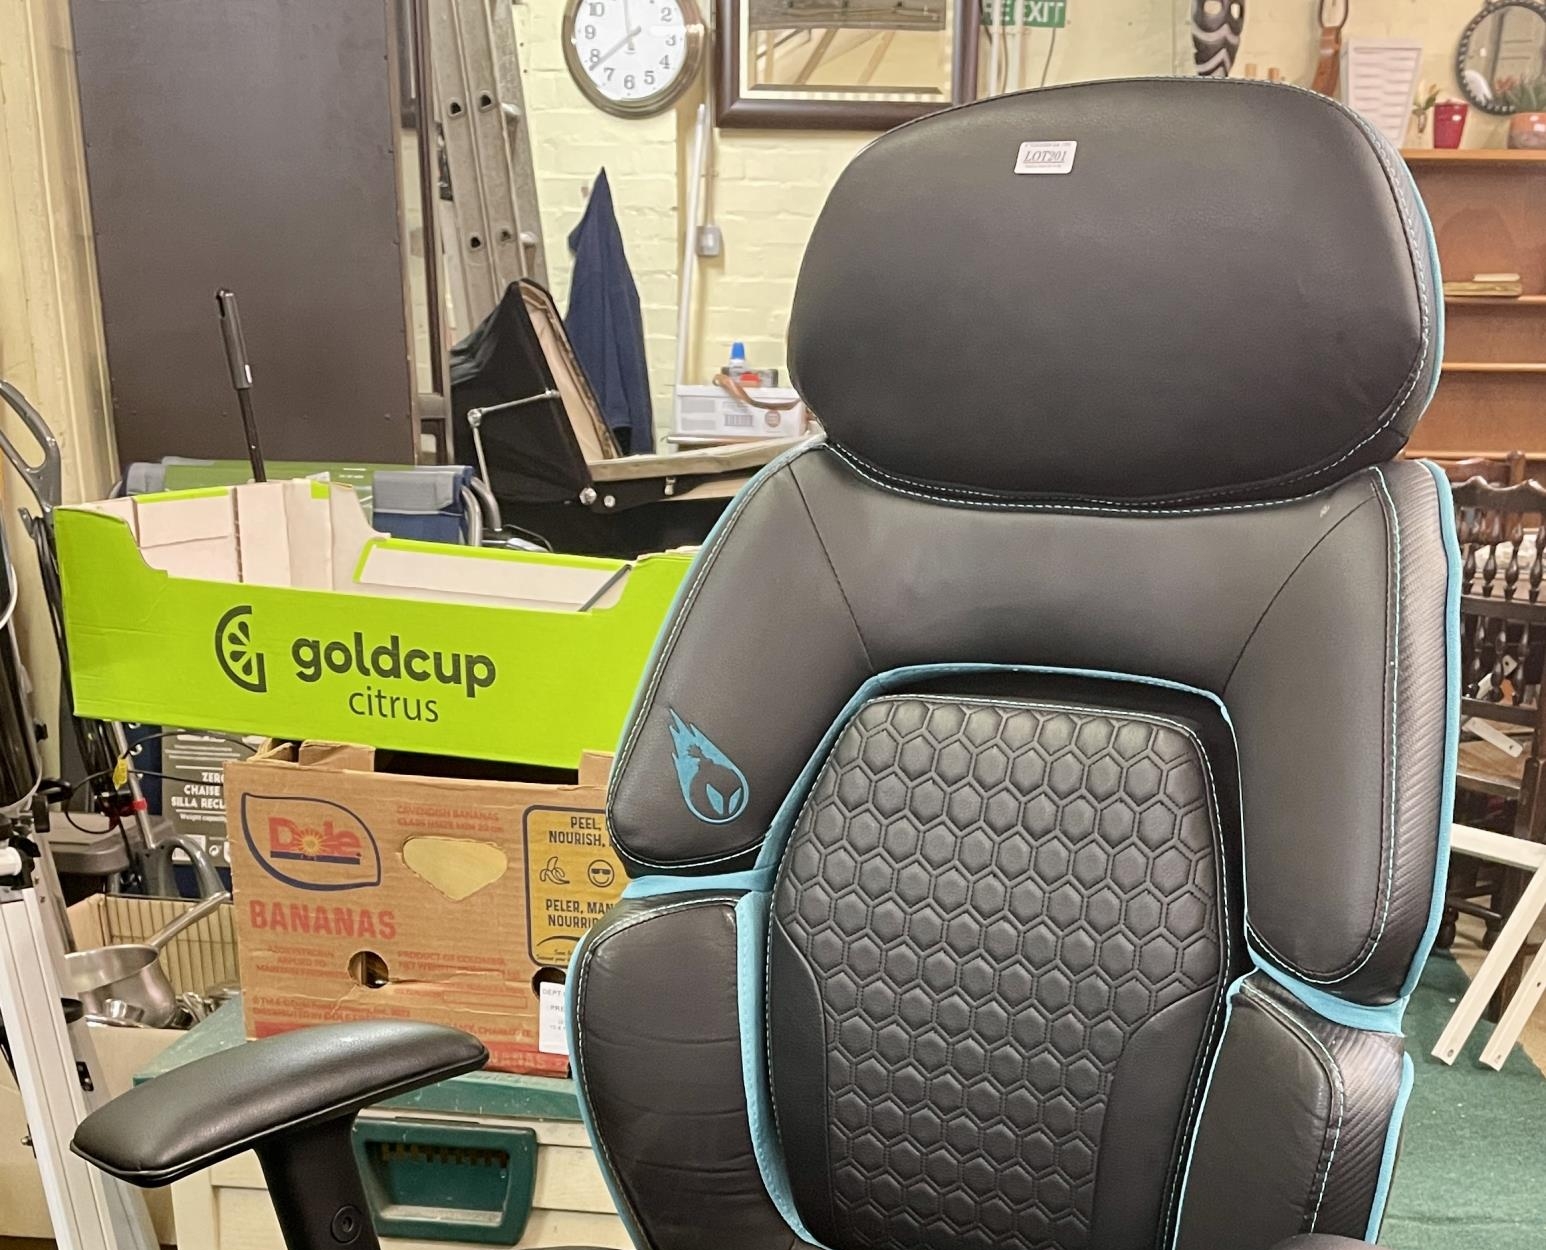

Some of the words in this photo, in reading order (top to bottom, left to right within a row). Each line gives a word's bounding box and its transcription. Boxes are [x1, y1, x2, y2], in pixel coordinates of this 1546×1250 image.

[660, 7, 672, 23] 2
[584, 24, 596, 40] 9
[589, 48, 601, 64] 8
[659, 54, 670, 70] 4
[603, 67, 615, 82] 7
[623, 74, 635, 90] 6
[644, 70, 655, 86] 5
[291, 631, 496, 697] goldcup
[347, 686, 440, 723] citrus
[183, 784, 221, 796] CHAISE
[171, 796, 198, 808] SILLA
[200, 798, 226, 810] RECL
[268, 816, 363, 857] Dole
[587, 901, 614, 916] MAN
[250, 899, 397, 940] BANANAS
